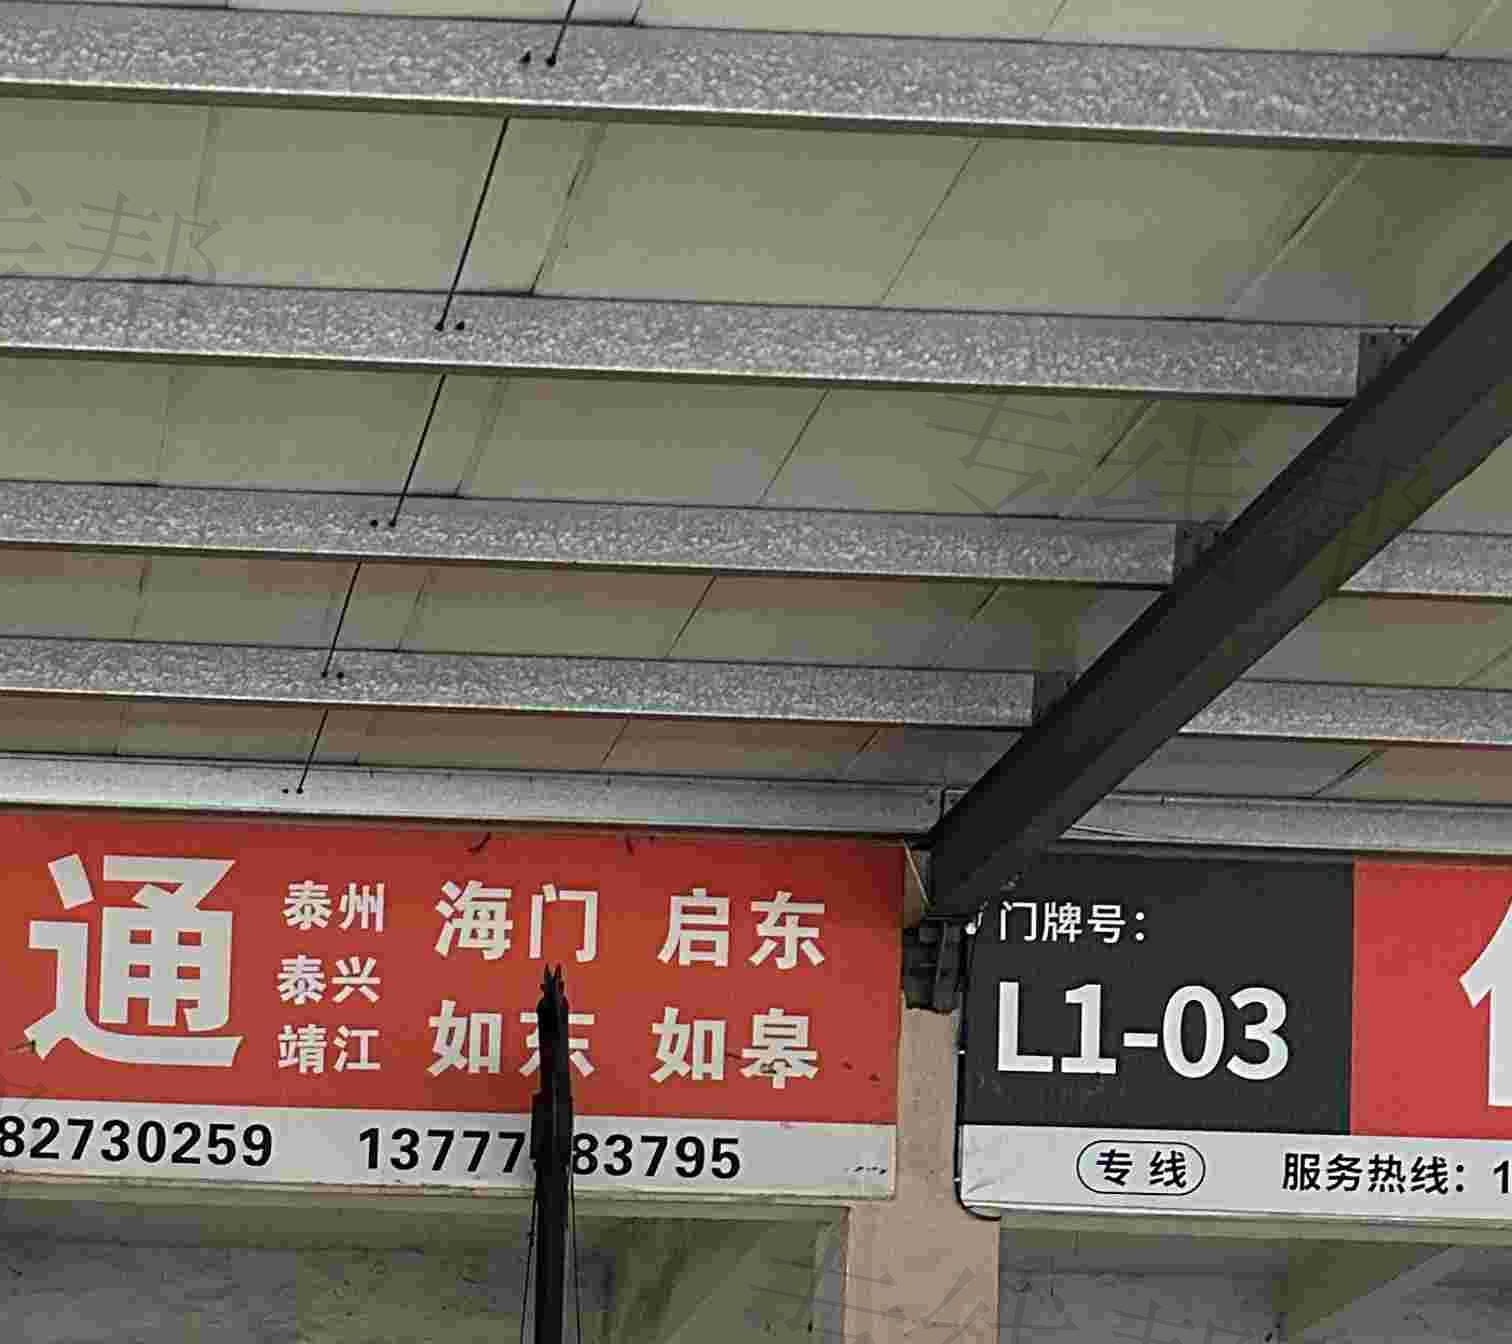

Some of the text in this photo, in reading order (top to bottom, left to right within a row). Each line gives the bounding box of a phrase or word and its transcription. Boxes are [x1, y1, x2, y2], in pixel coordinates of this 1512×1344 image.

[283, 881, 386, 933] 泰州
[434, 879, 826, 970] 海门 启东
[277, 954, 381, 1006] 泰兴
[278, 1023, 381, 1075] 靖江
[650, 1005, 821, 1090] 如皋
[996, 981, 1289, 1081] L1-03
[358, 1126, 741, 1180] 1377783795
[1096, 1148, 1187, 1189] 专线
